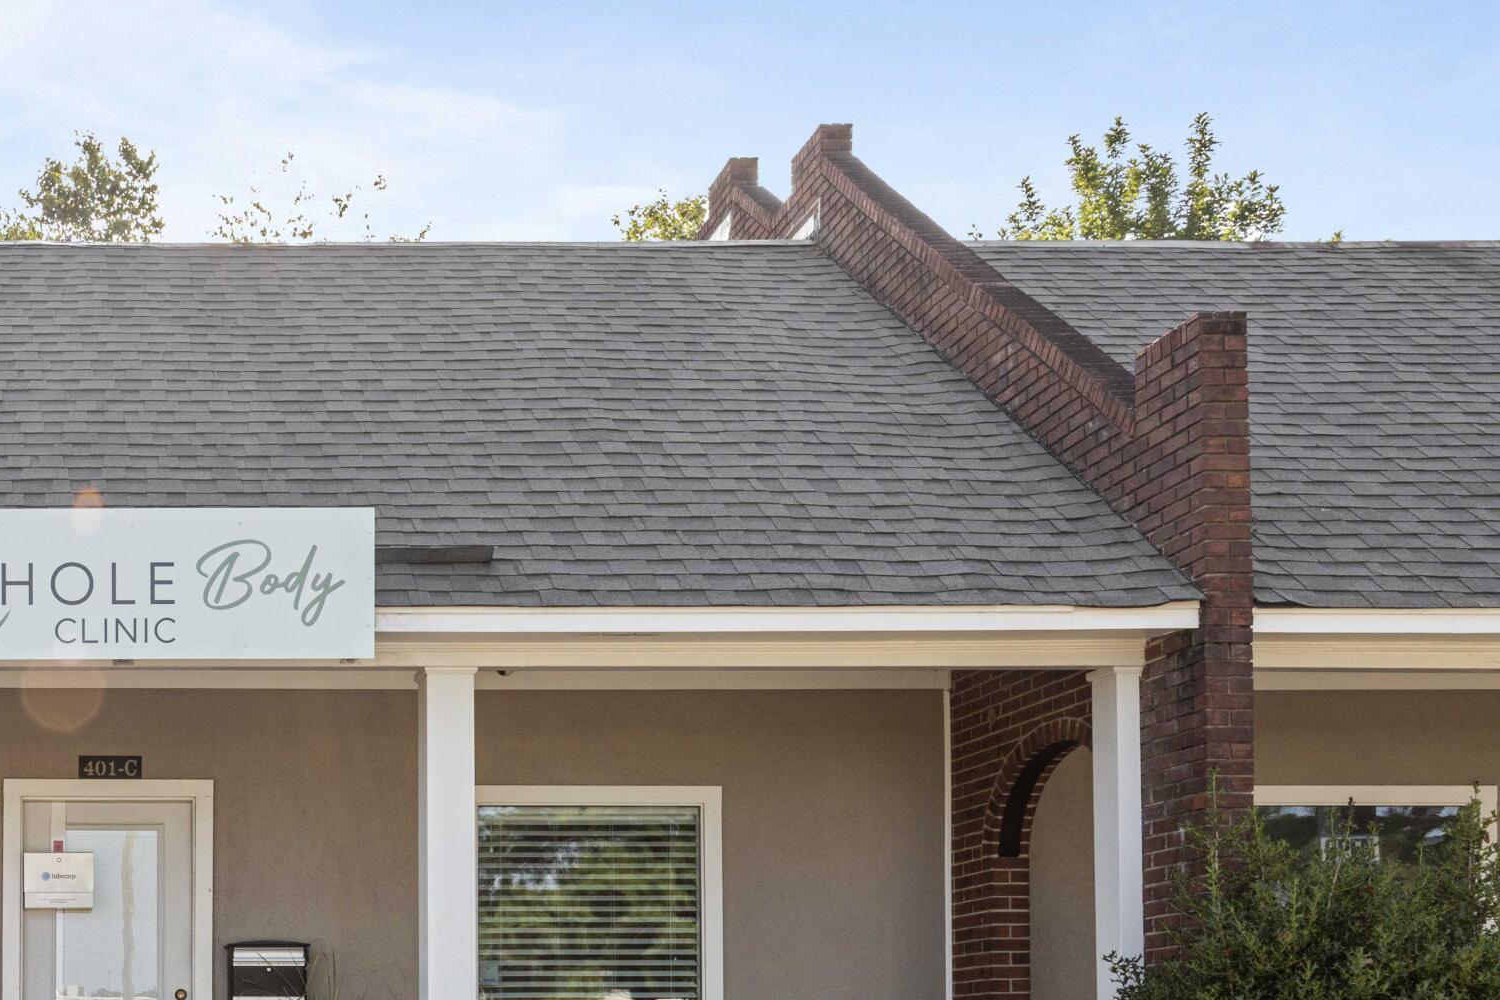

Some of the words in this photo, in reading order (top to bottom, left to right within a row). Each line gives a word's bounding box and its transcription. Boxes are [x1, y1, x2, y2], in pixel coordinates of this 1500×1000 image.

[195, 538, 346, 627] Body
[54, 617, 176, 644] CLINIC
[83, 759, 138, 777] 401-C
